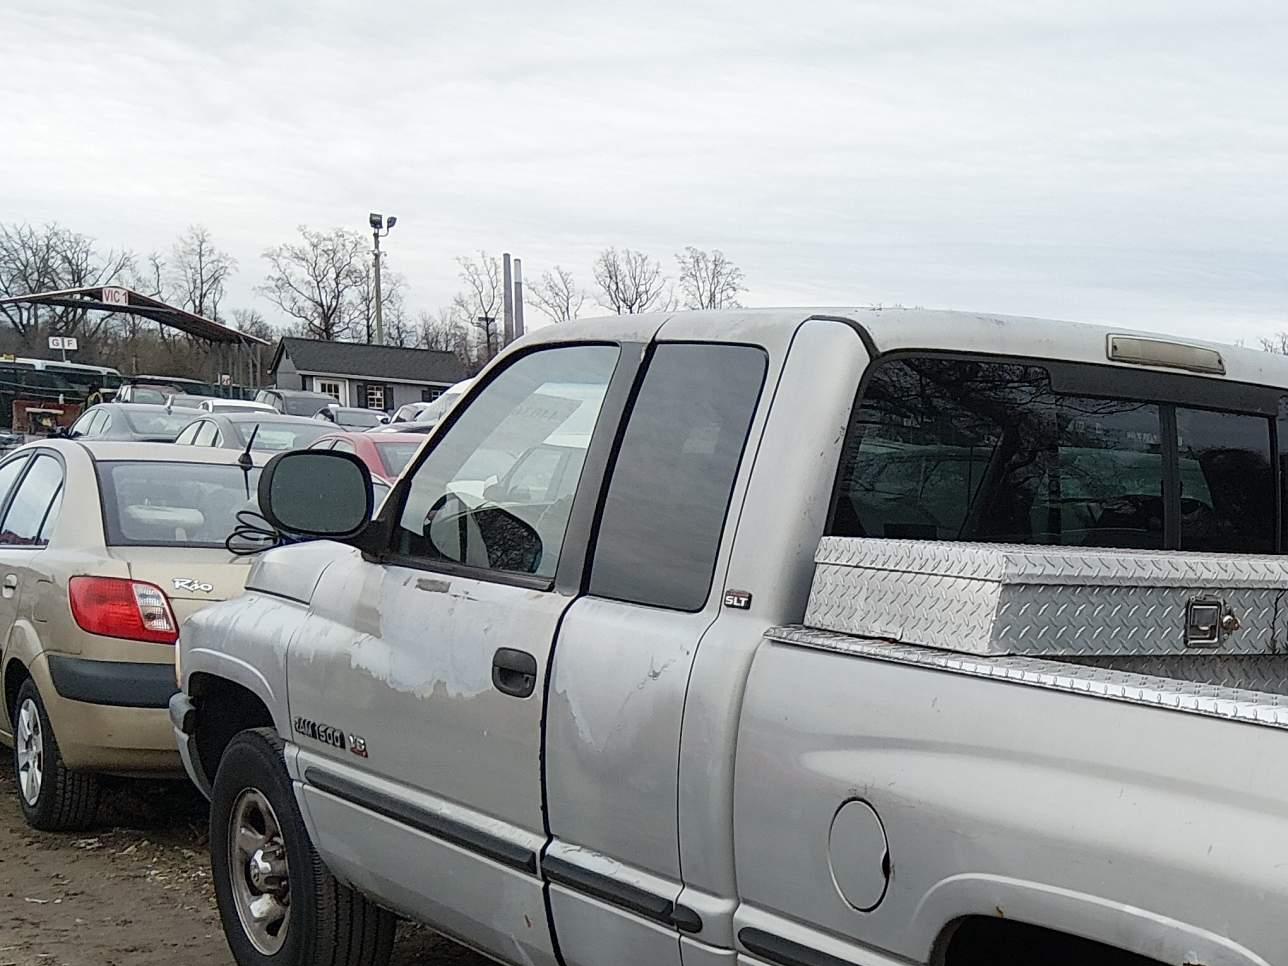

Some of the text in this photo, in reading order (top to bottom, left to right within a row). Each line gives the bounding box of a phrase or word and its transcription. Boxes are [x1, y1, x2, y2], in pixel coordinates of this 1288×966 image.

[104, 289, 128, 304] VIC 1
[51, 339, 60, 347] G
[67, 339, 73, 347] F
[172, 578, 213, 592] Rio
[725, 595, 749, 607] SLT
